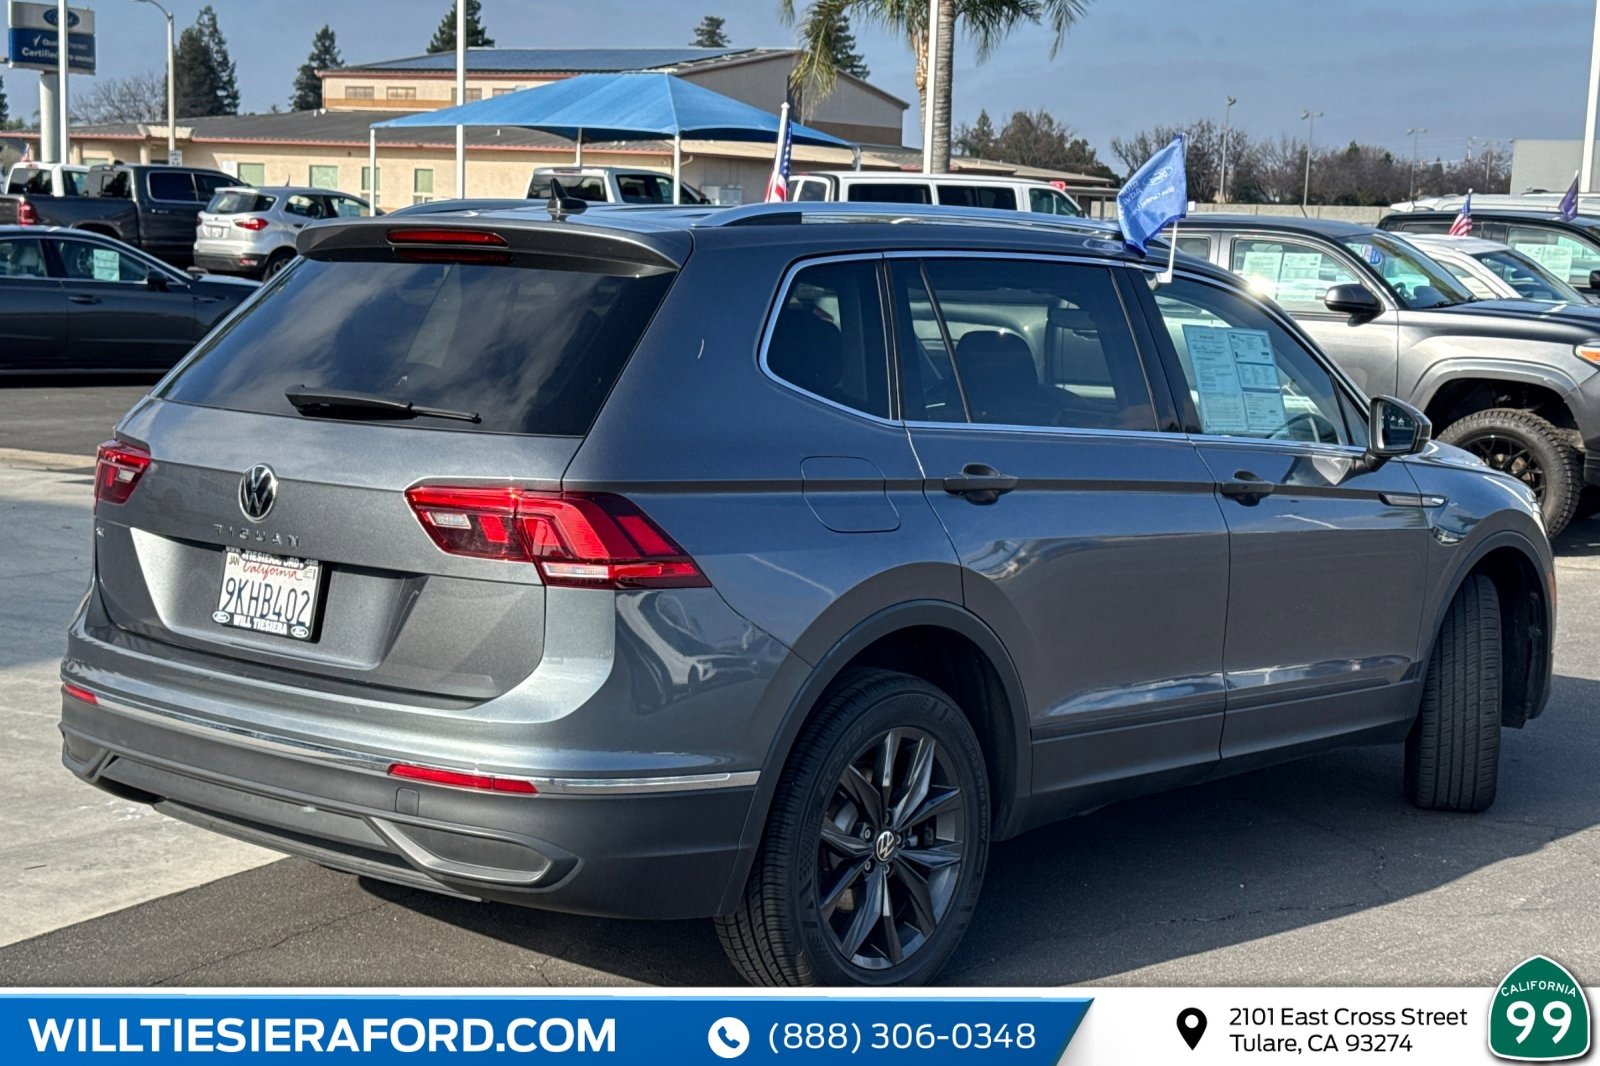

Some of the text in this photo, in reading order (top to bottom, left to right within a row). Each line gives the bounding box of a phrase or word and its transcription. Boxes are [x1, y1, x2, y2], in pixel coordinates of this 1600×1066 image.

[213, 524, 300, 547] TIGUAN
[242, 559, 303, 581] California
[221, 577, 311, 627] 9KHB402
[233, 614, 252, 628] WILL
[253, 617, 288, 636] TIESIERA
